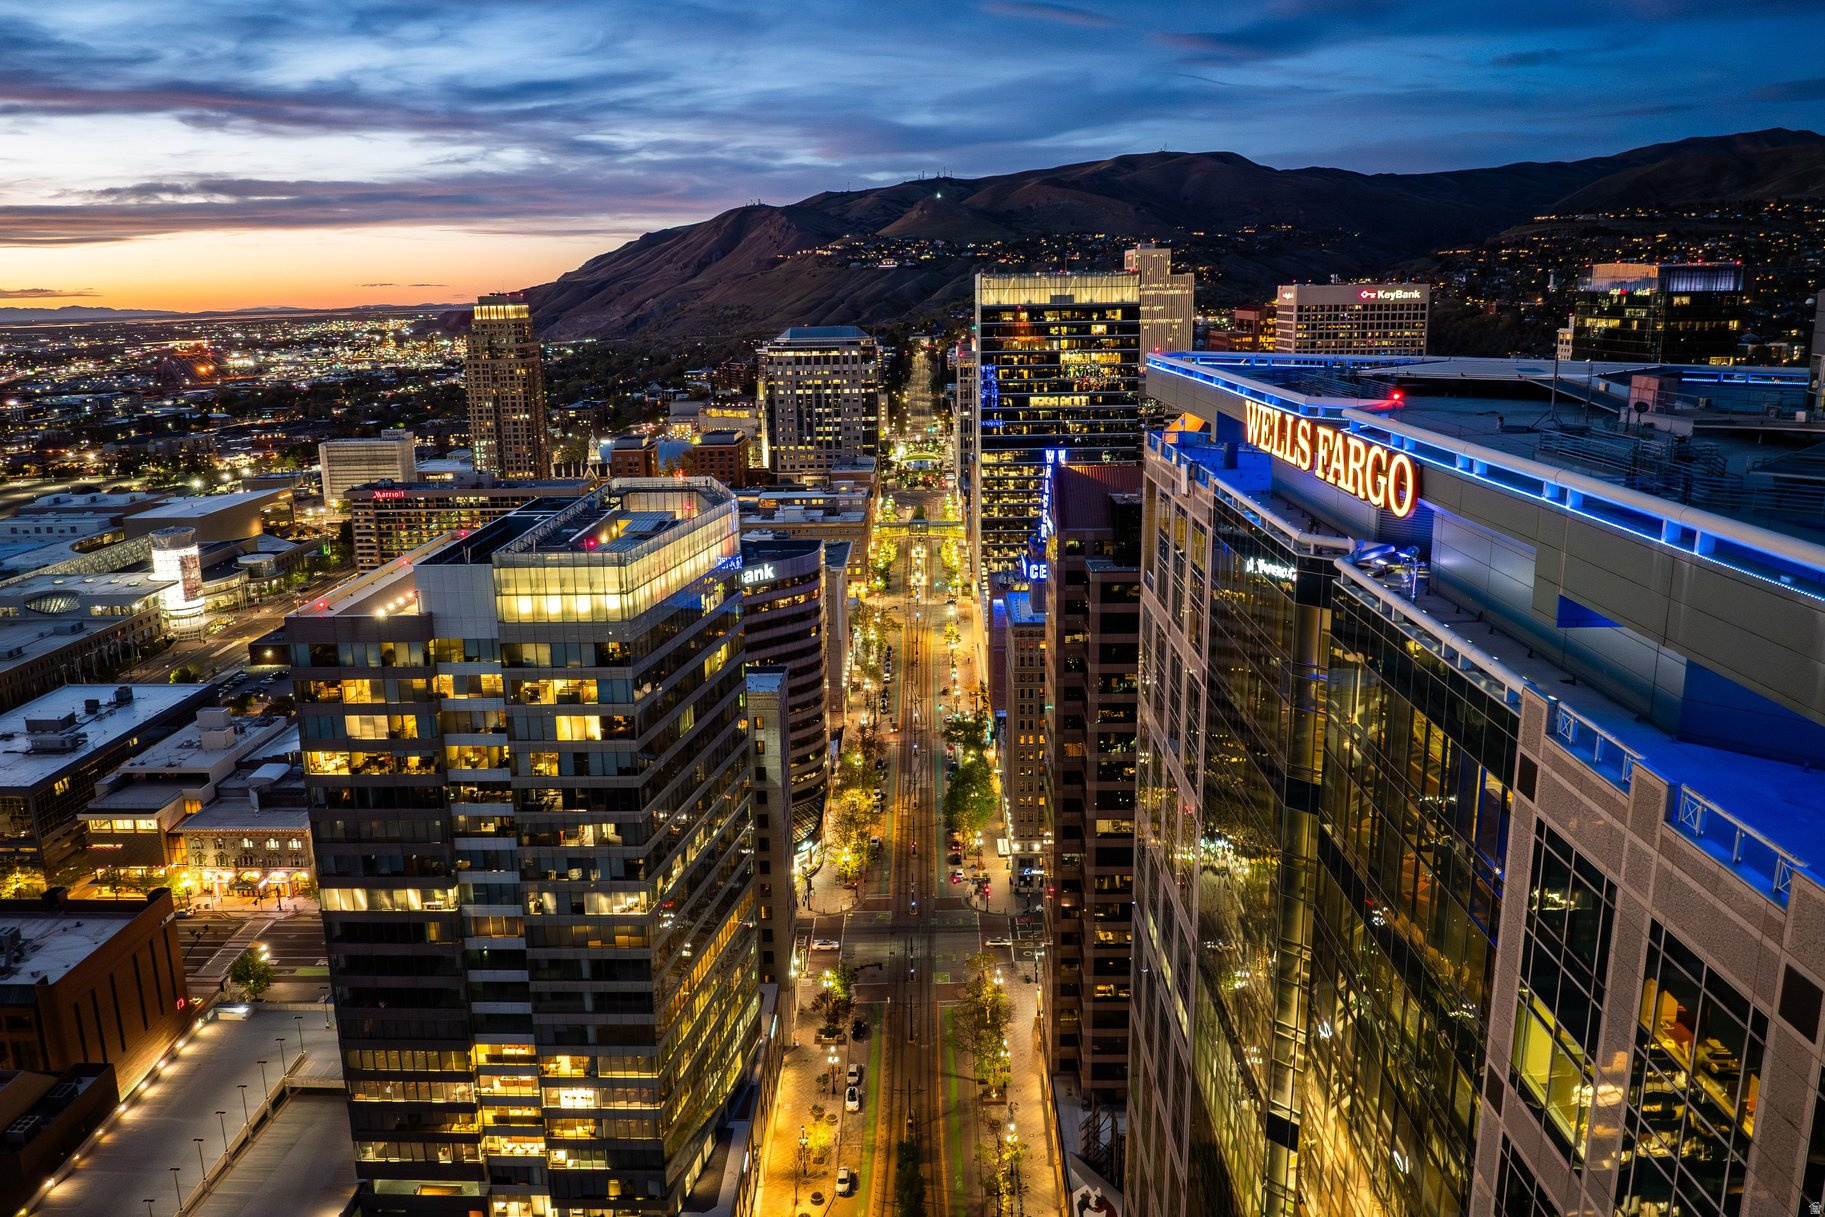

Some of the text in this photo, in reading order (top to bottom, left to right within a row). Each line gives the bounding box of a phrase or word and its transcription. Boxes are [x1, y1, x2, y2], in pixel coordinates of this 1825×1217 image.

[1377, 290, 1420, 300] KeyBank
[1246, 400, 1413, 517] WELLS FARGO
[741, 564, 775, 583] ank
